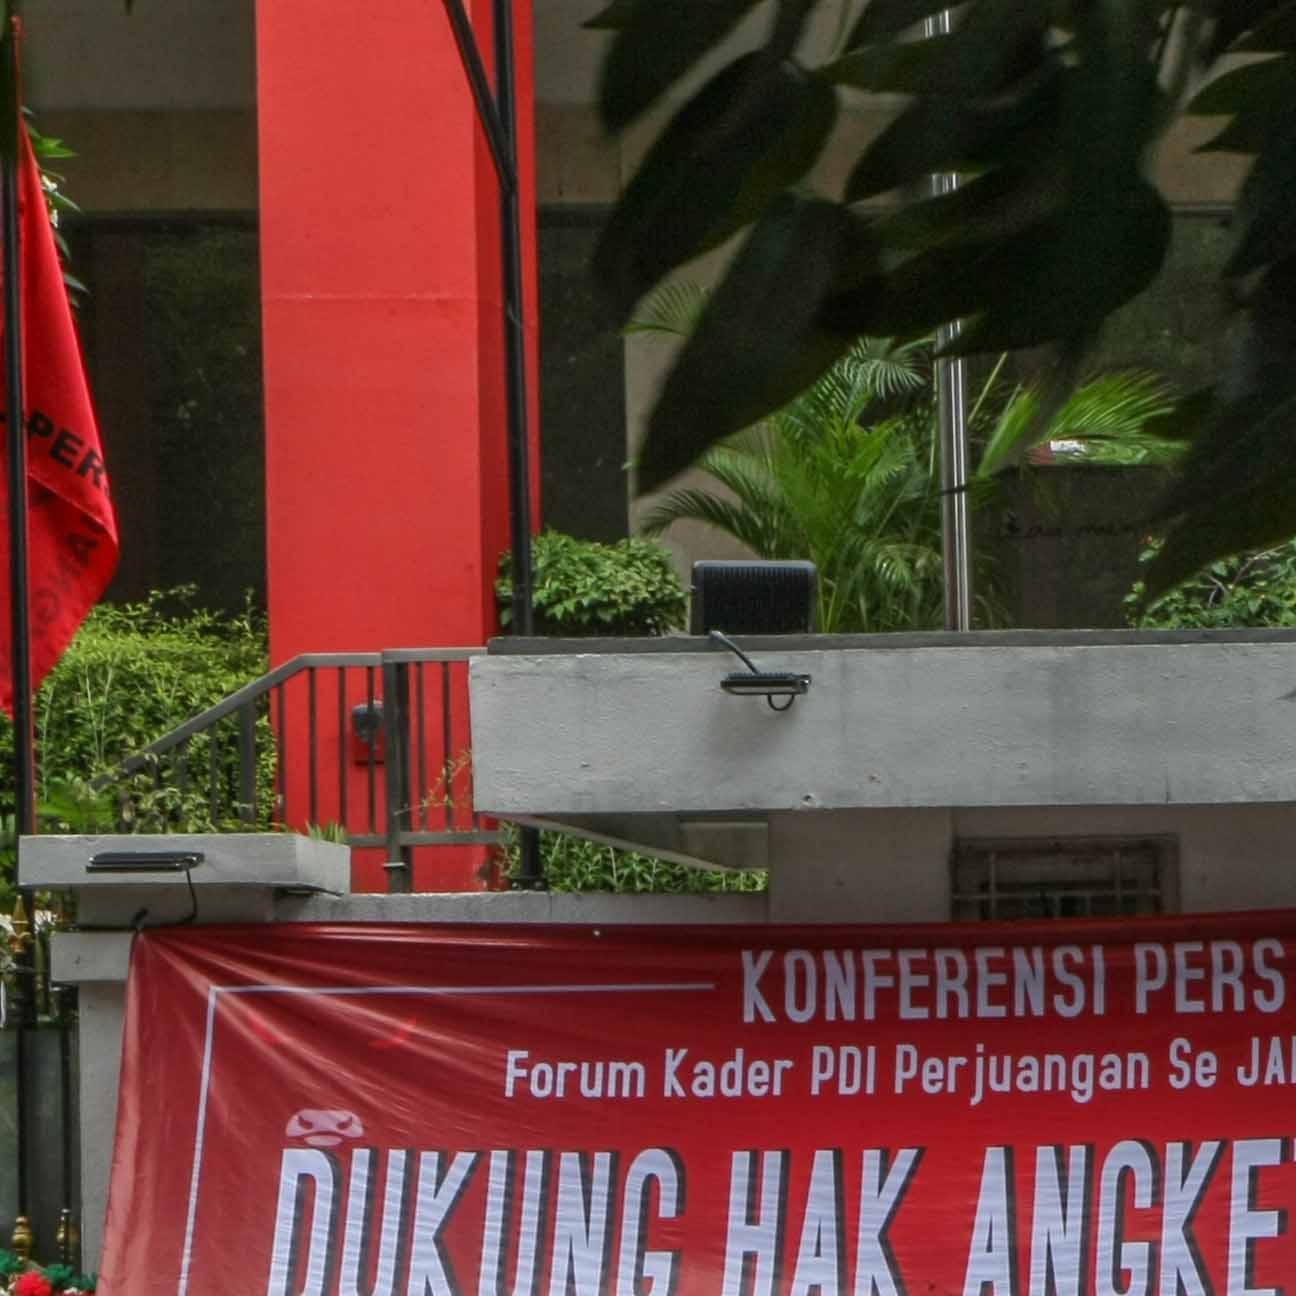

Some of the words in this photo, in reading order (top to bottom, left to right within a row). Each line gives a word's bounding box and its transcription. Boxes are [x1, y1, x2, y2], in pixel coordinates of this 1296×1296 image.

[27, 409, 110, 496] PER
[741, 943, 1103, 1023] KONFERENSI
[1134, 937, 1286, 1014] PERS
[505, 1050, 645, 1099] Forum
[663, 1047, 794, 1096] Kader
[811, 1046, 875, 1095] PDI
[894, 1043, 1149, 1106] Perjuangan
[1169, 1038, 1217, 1088] Se
